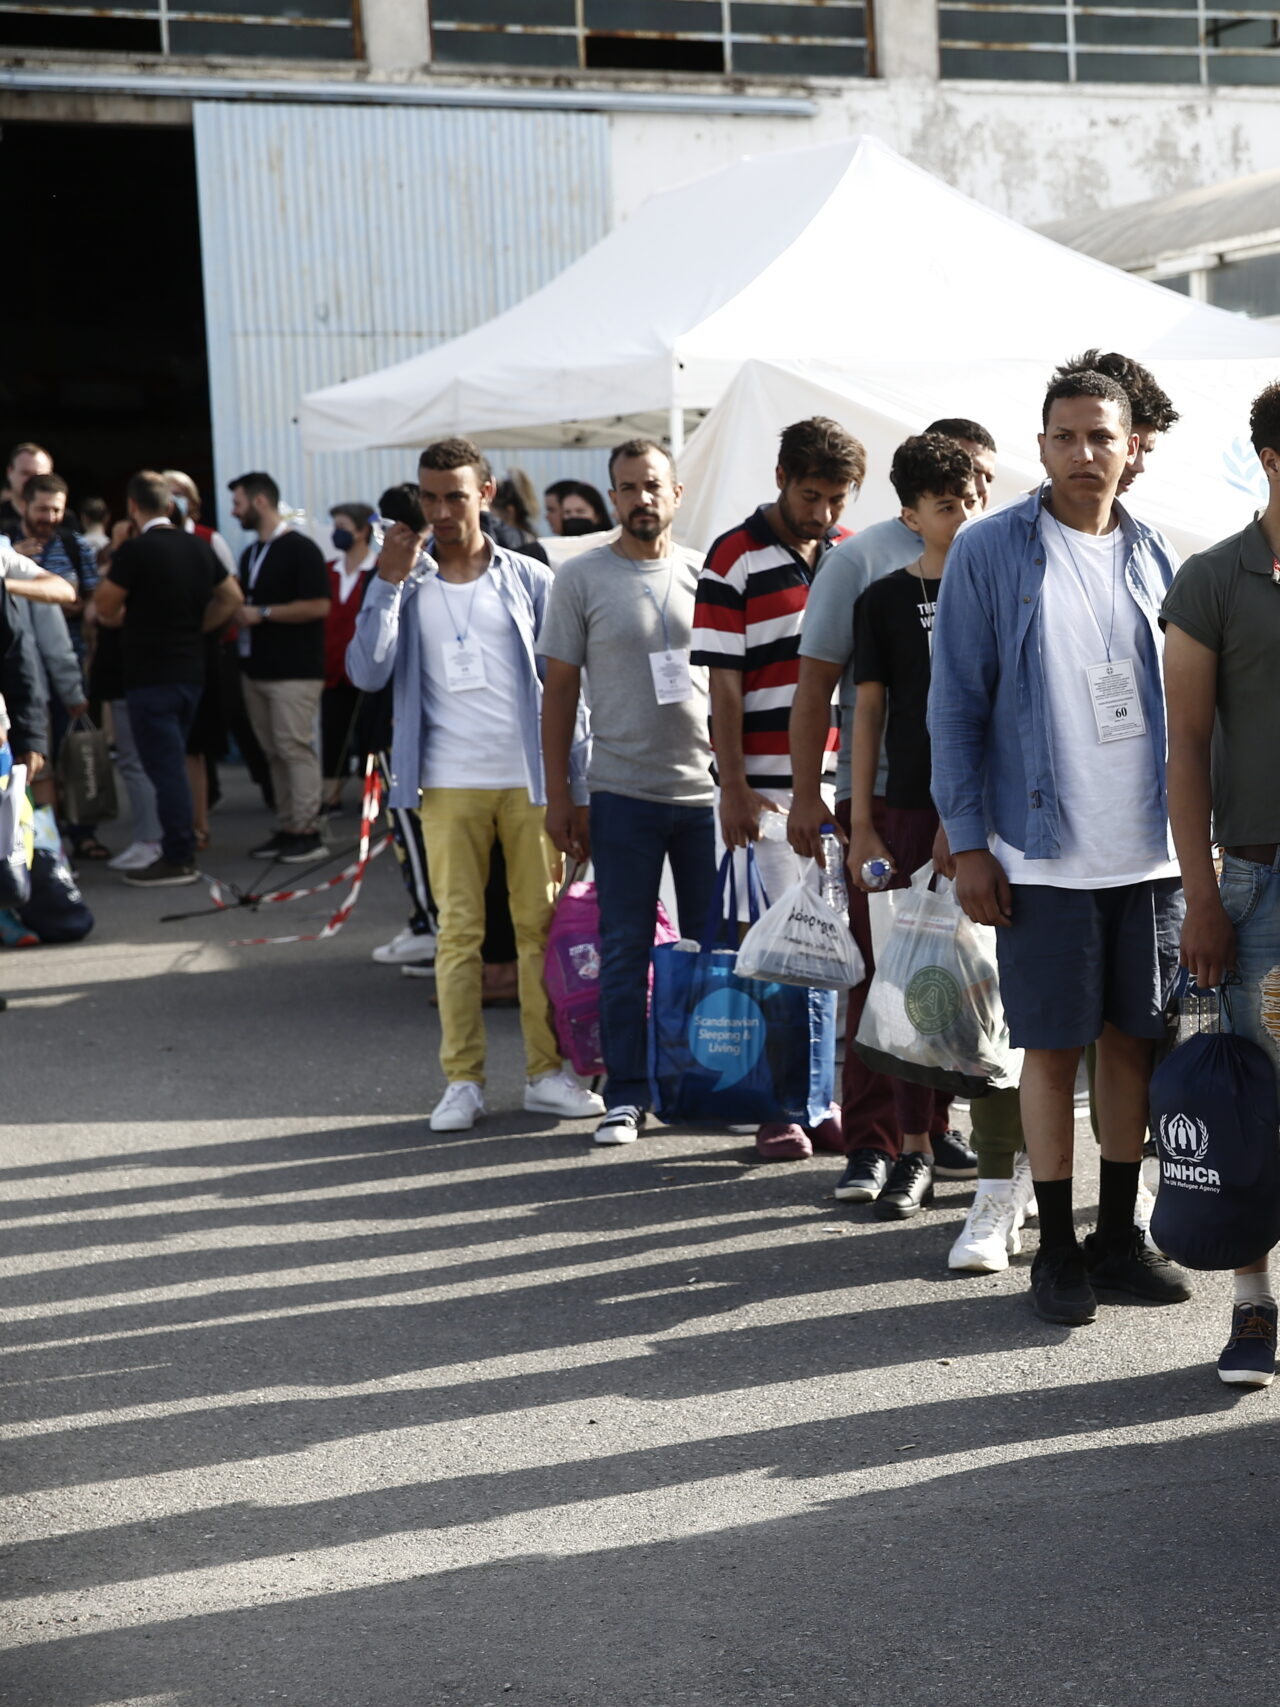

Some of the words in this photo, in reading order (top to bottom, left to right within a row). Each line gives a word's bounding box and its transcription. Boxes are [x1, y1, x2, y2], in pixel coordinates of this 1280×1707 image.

[1115, 707, 1128, 718] 60
[695, 1016, 759, 1027] Scandinavian
[698, 1029, 741, 1042] Sleeping
[708, 1042, 741, 1056] Living
[1163, 1161, 1221, 1185] UNHCR
[1177, 1181, 1199, 1190] Refugee
[1199, 1184, 1221, 1194] Agency
